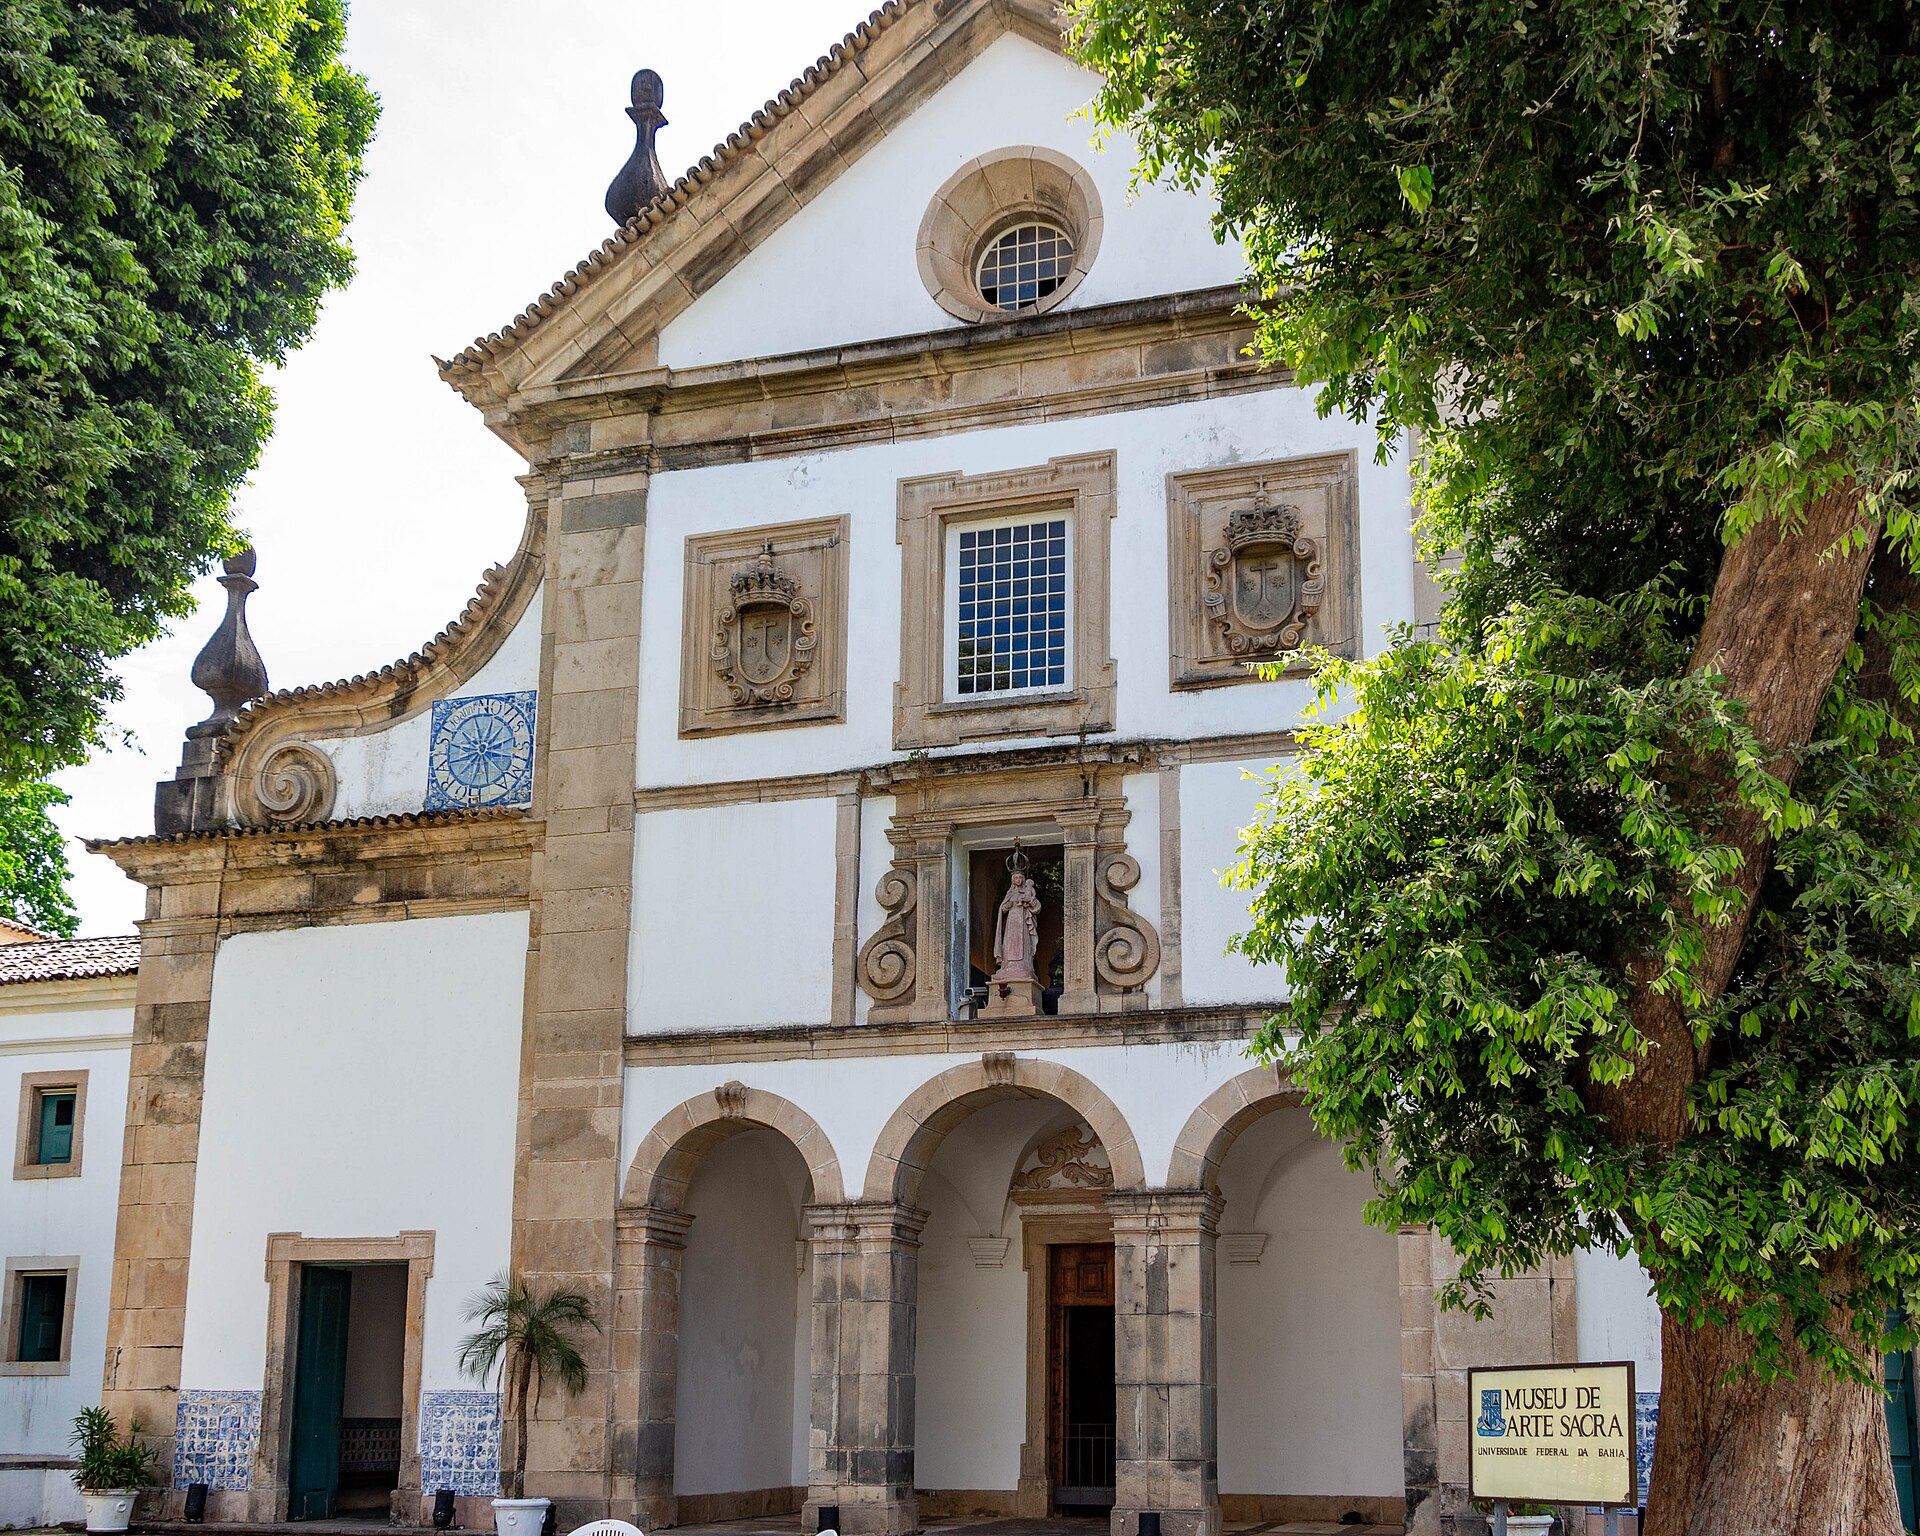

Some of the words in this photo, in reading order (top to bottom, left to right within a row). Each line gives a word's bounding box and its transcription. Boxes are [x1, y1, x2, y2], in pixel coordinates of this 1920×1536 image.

[1505, 1387, 1567, 1410] MUSEU
[1575, 1386, 1601, 1409] DE
[1506, 1415, 1554, 1437] ARTE
[1560, 1414, 1624, 1438] SACRA
[1477, 1447, 1528, 1456] UNIVERSIDADE
[1536, 1448, 1569, 1457] FEDERAL
[1578, 1448, 1588, 1457] DA
[1598, 1448, 1625, 1458] BAHIA
